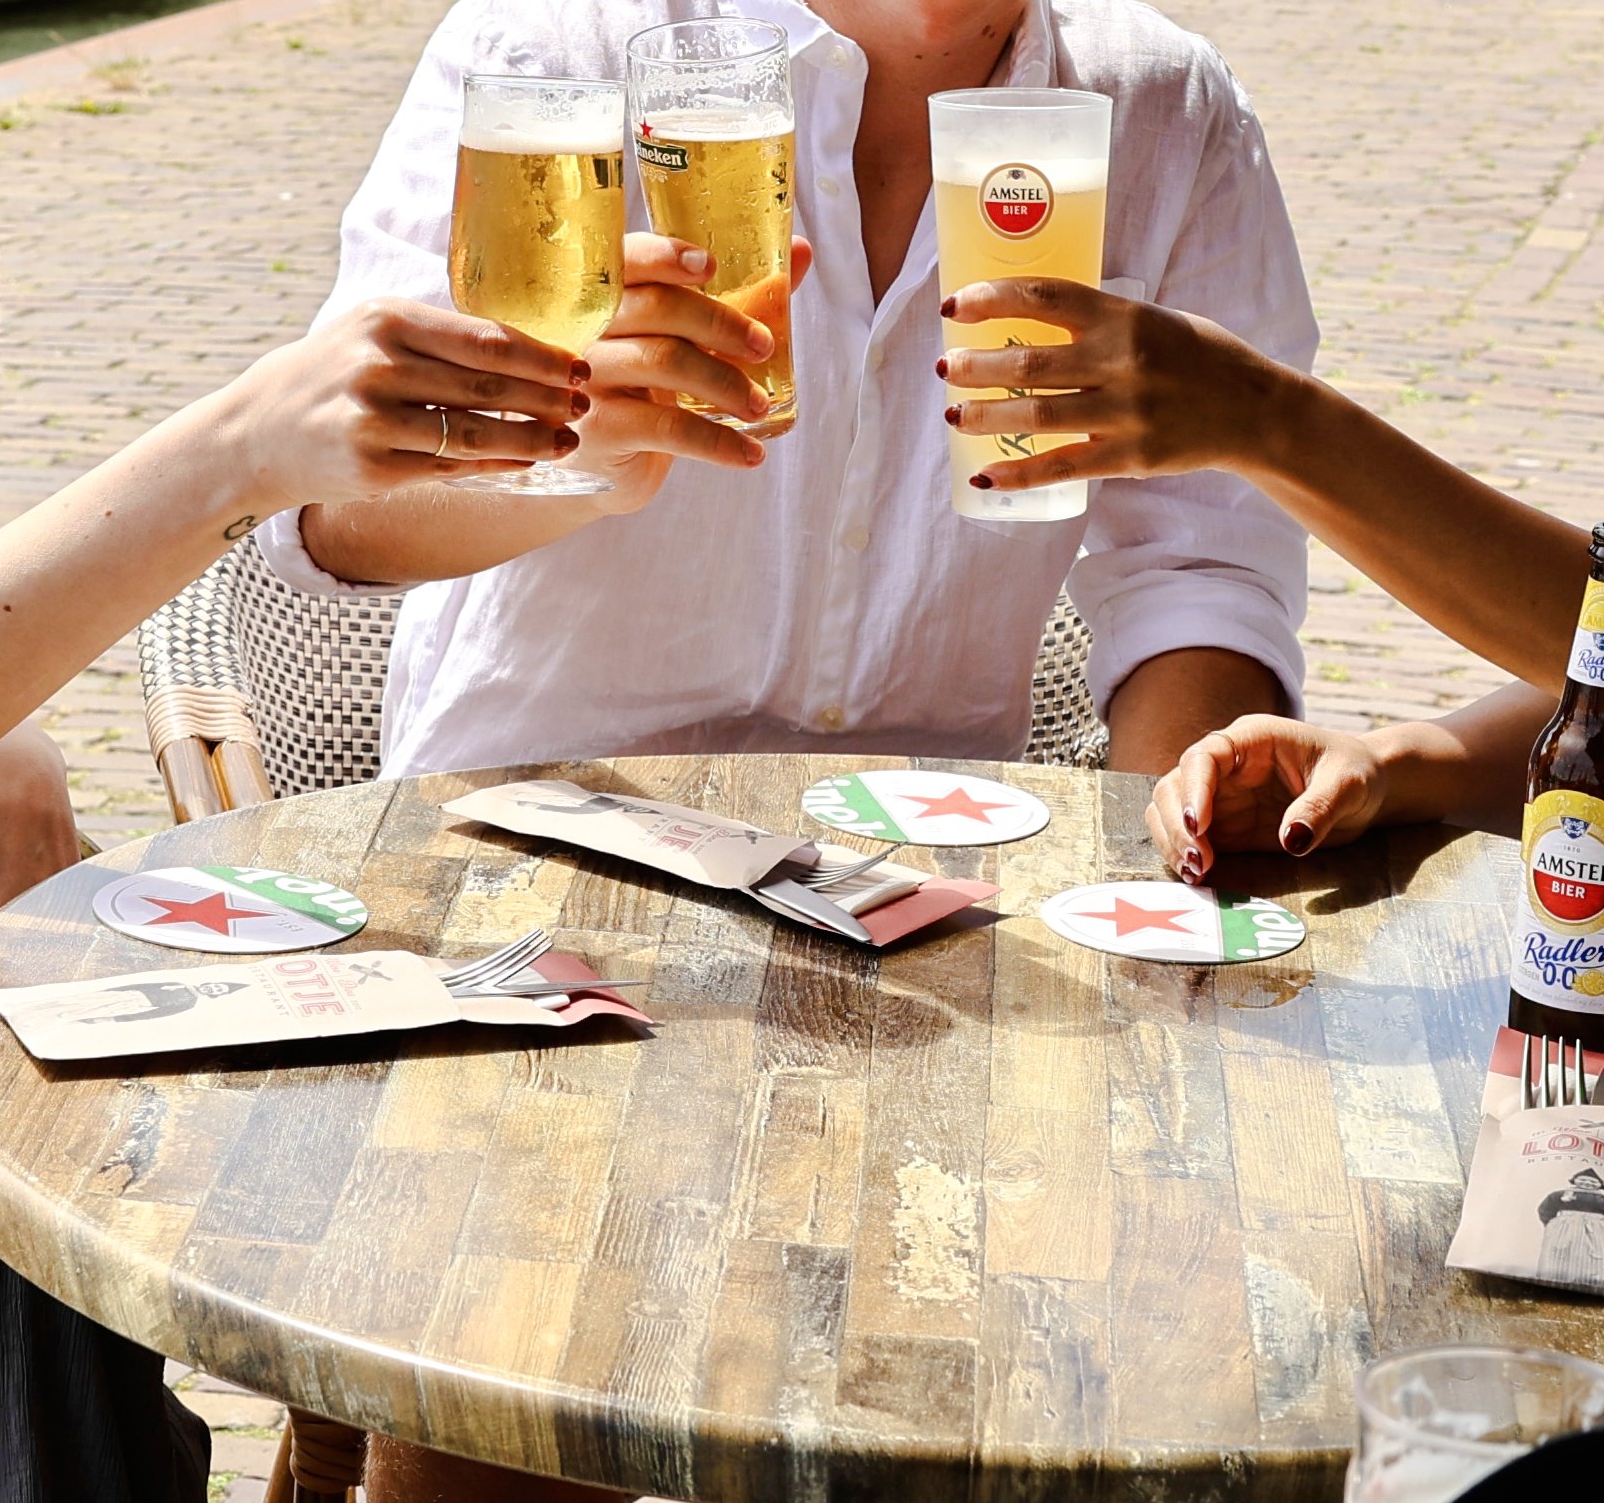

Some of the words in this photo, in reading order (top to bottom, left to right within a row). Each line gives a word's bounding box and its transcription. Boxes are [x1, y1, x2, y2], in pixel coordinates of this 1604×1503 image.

[989, 187, 1044, 201] AMSTEL
[1002, 205, 1028, 215] BIER
[1551, 880, 1586, 899] BIER
